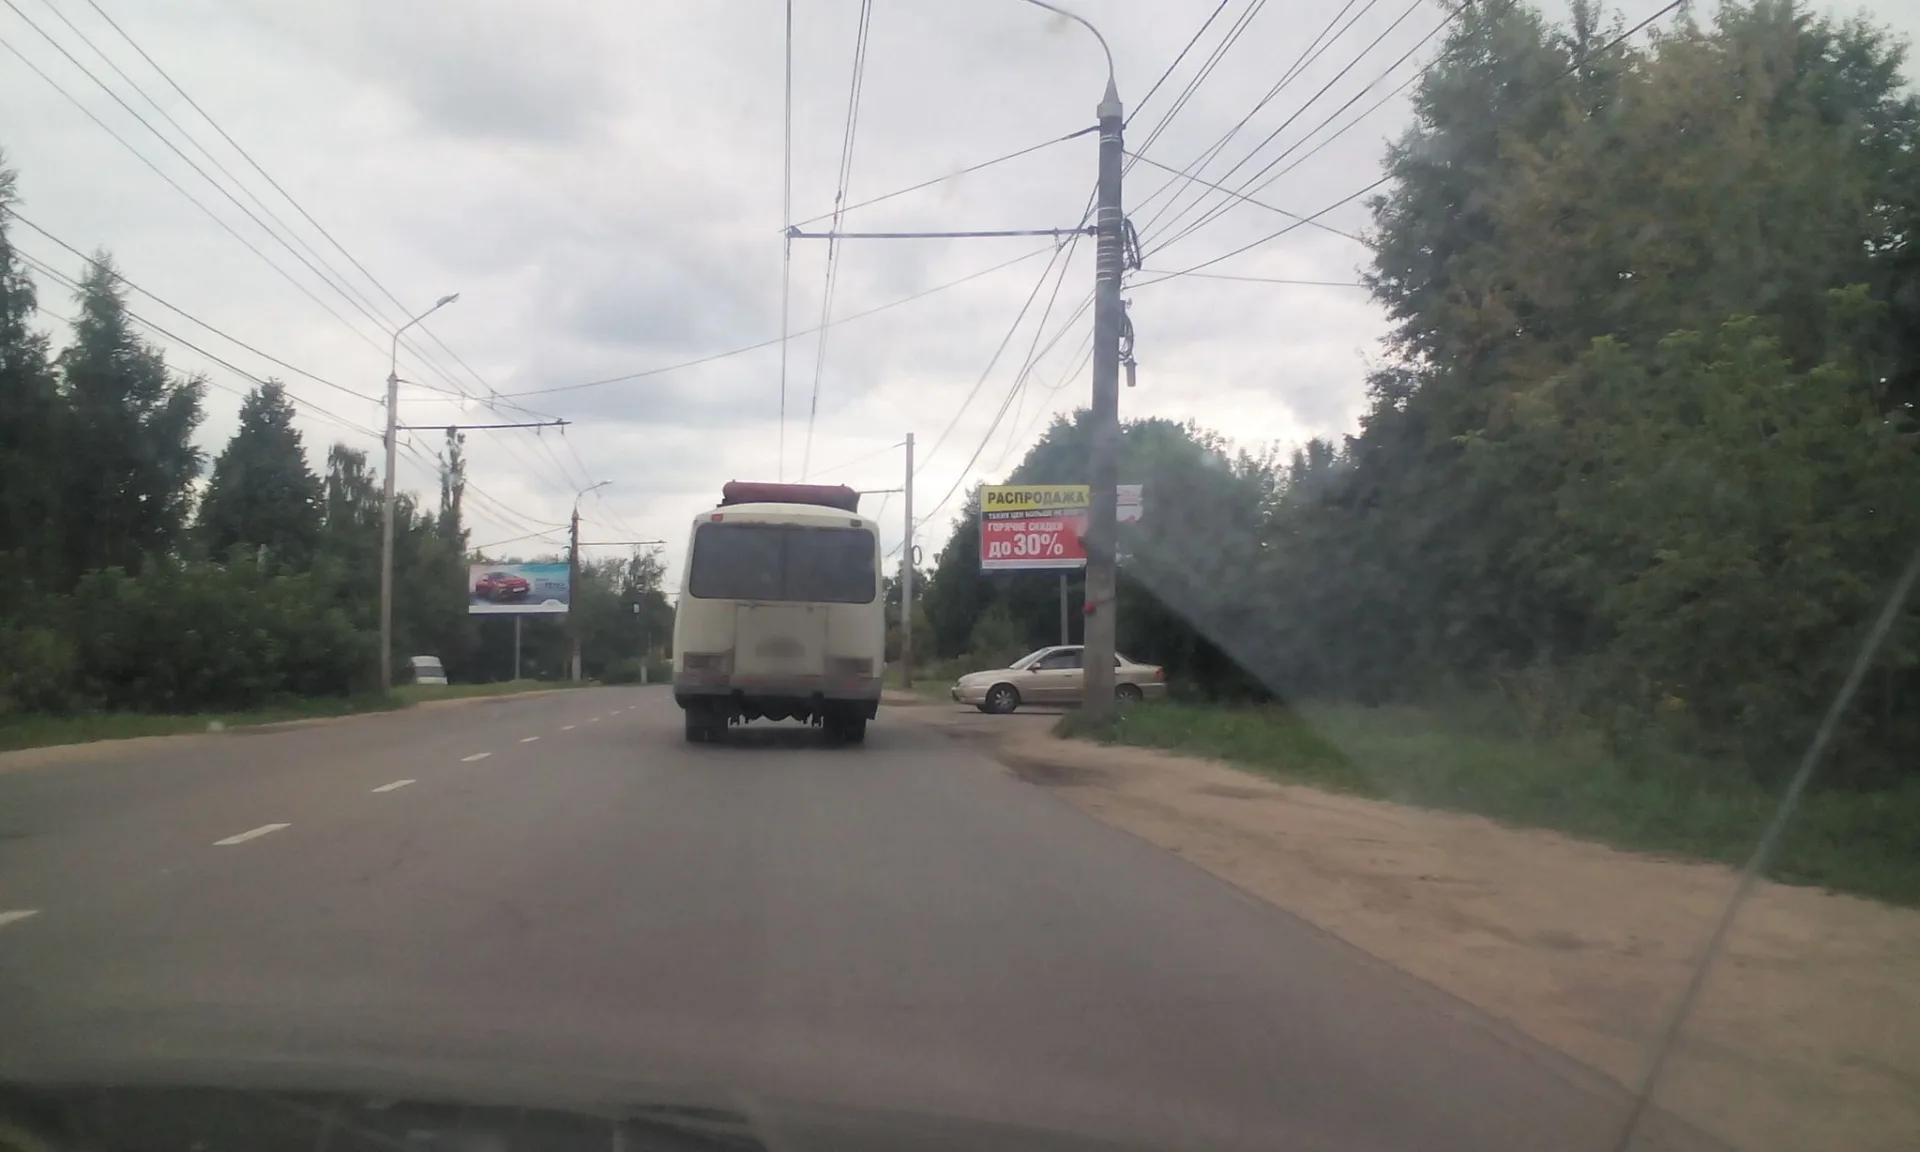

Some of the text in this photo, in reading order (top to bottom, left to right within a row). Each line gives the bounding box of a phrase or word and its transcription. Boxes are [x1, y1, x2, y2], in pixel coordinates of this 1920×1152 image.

[988, 491, 1085, 504] РАСПРОДАЖА
[987, 522, 1064, 531] ГОРЯЧИЕ СКИДКИ
[1013, 533, 1064, 556] 30%
